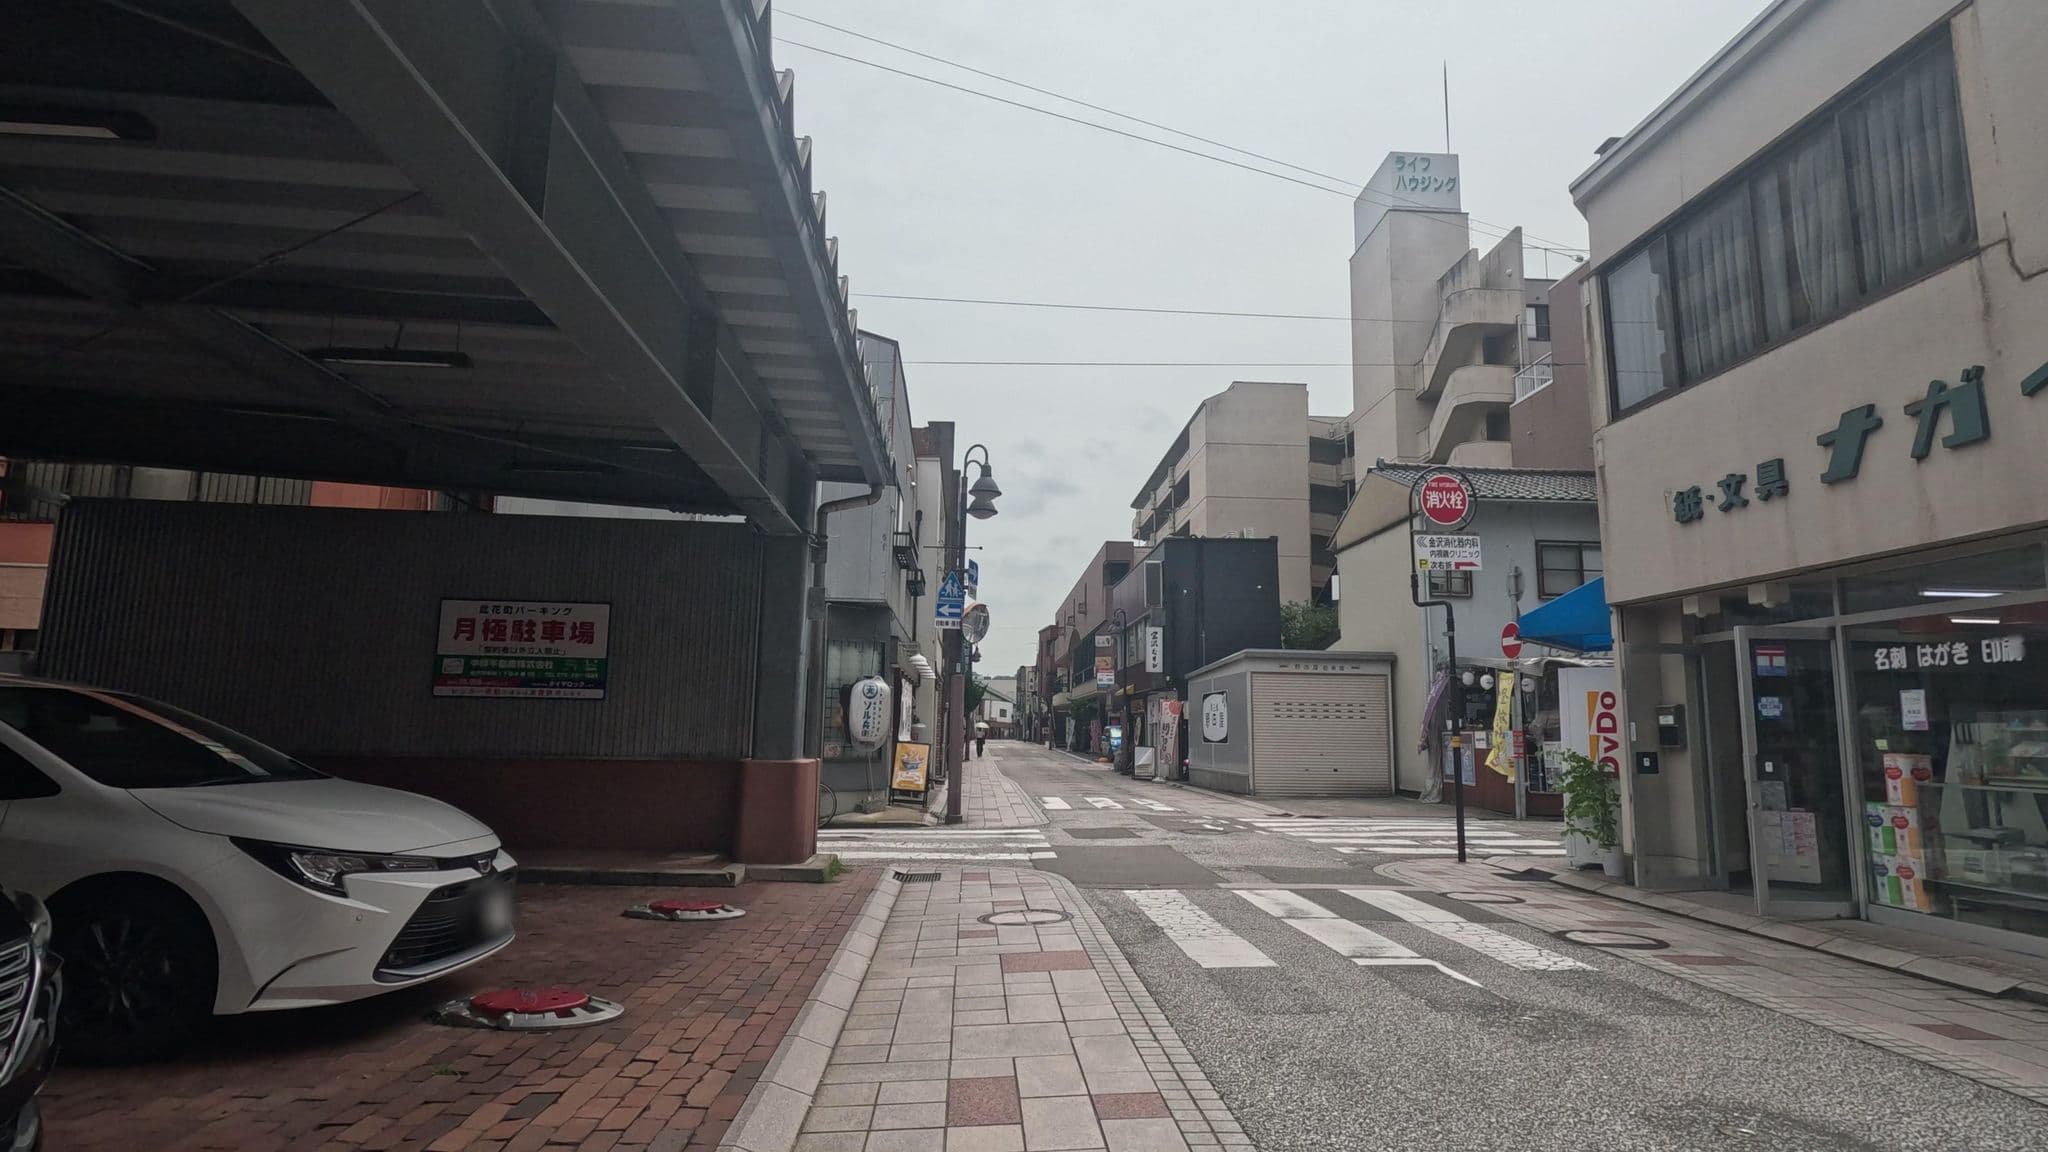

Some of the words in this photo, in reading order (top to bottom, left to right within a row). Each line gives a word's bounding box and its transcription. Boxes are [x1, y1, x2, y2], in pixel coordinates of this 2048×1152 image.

[1394, 156, 1431, 173] ライフ
[1395, 175, 1457, 192] ハウジング
[1817, 362, 2048, 484] ナガ
[1425, 490, 1464, 509] 消火栓
[1673, 458, 1790, 523] 紙・文具
[1428, 537, 1479, 548] 金沢消化器内科
[1419, 559, 1428, 569] P
[1430, 561, 1452, 570] 次右折
[453, 617, 595, 645] 月極駐車場
[1874, 646, 1908, 671] 名刺
[1917, 641, 1970, 668] はがき
